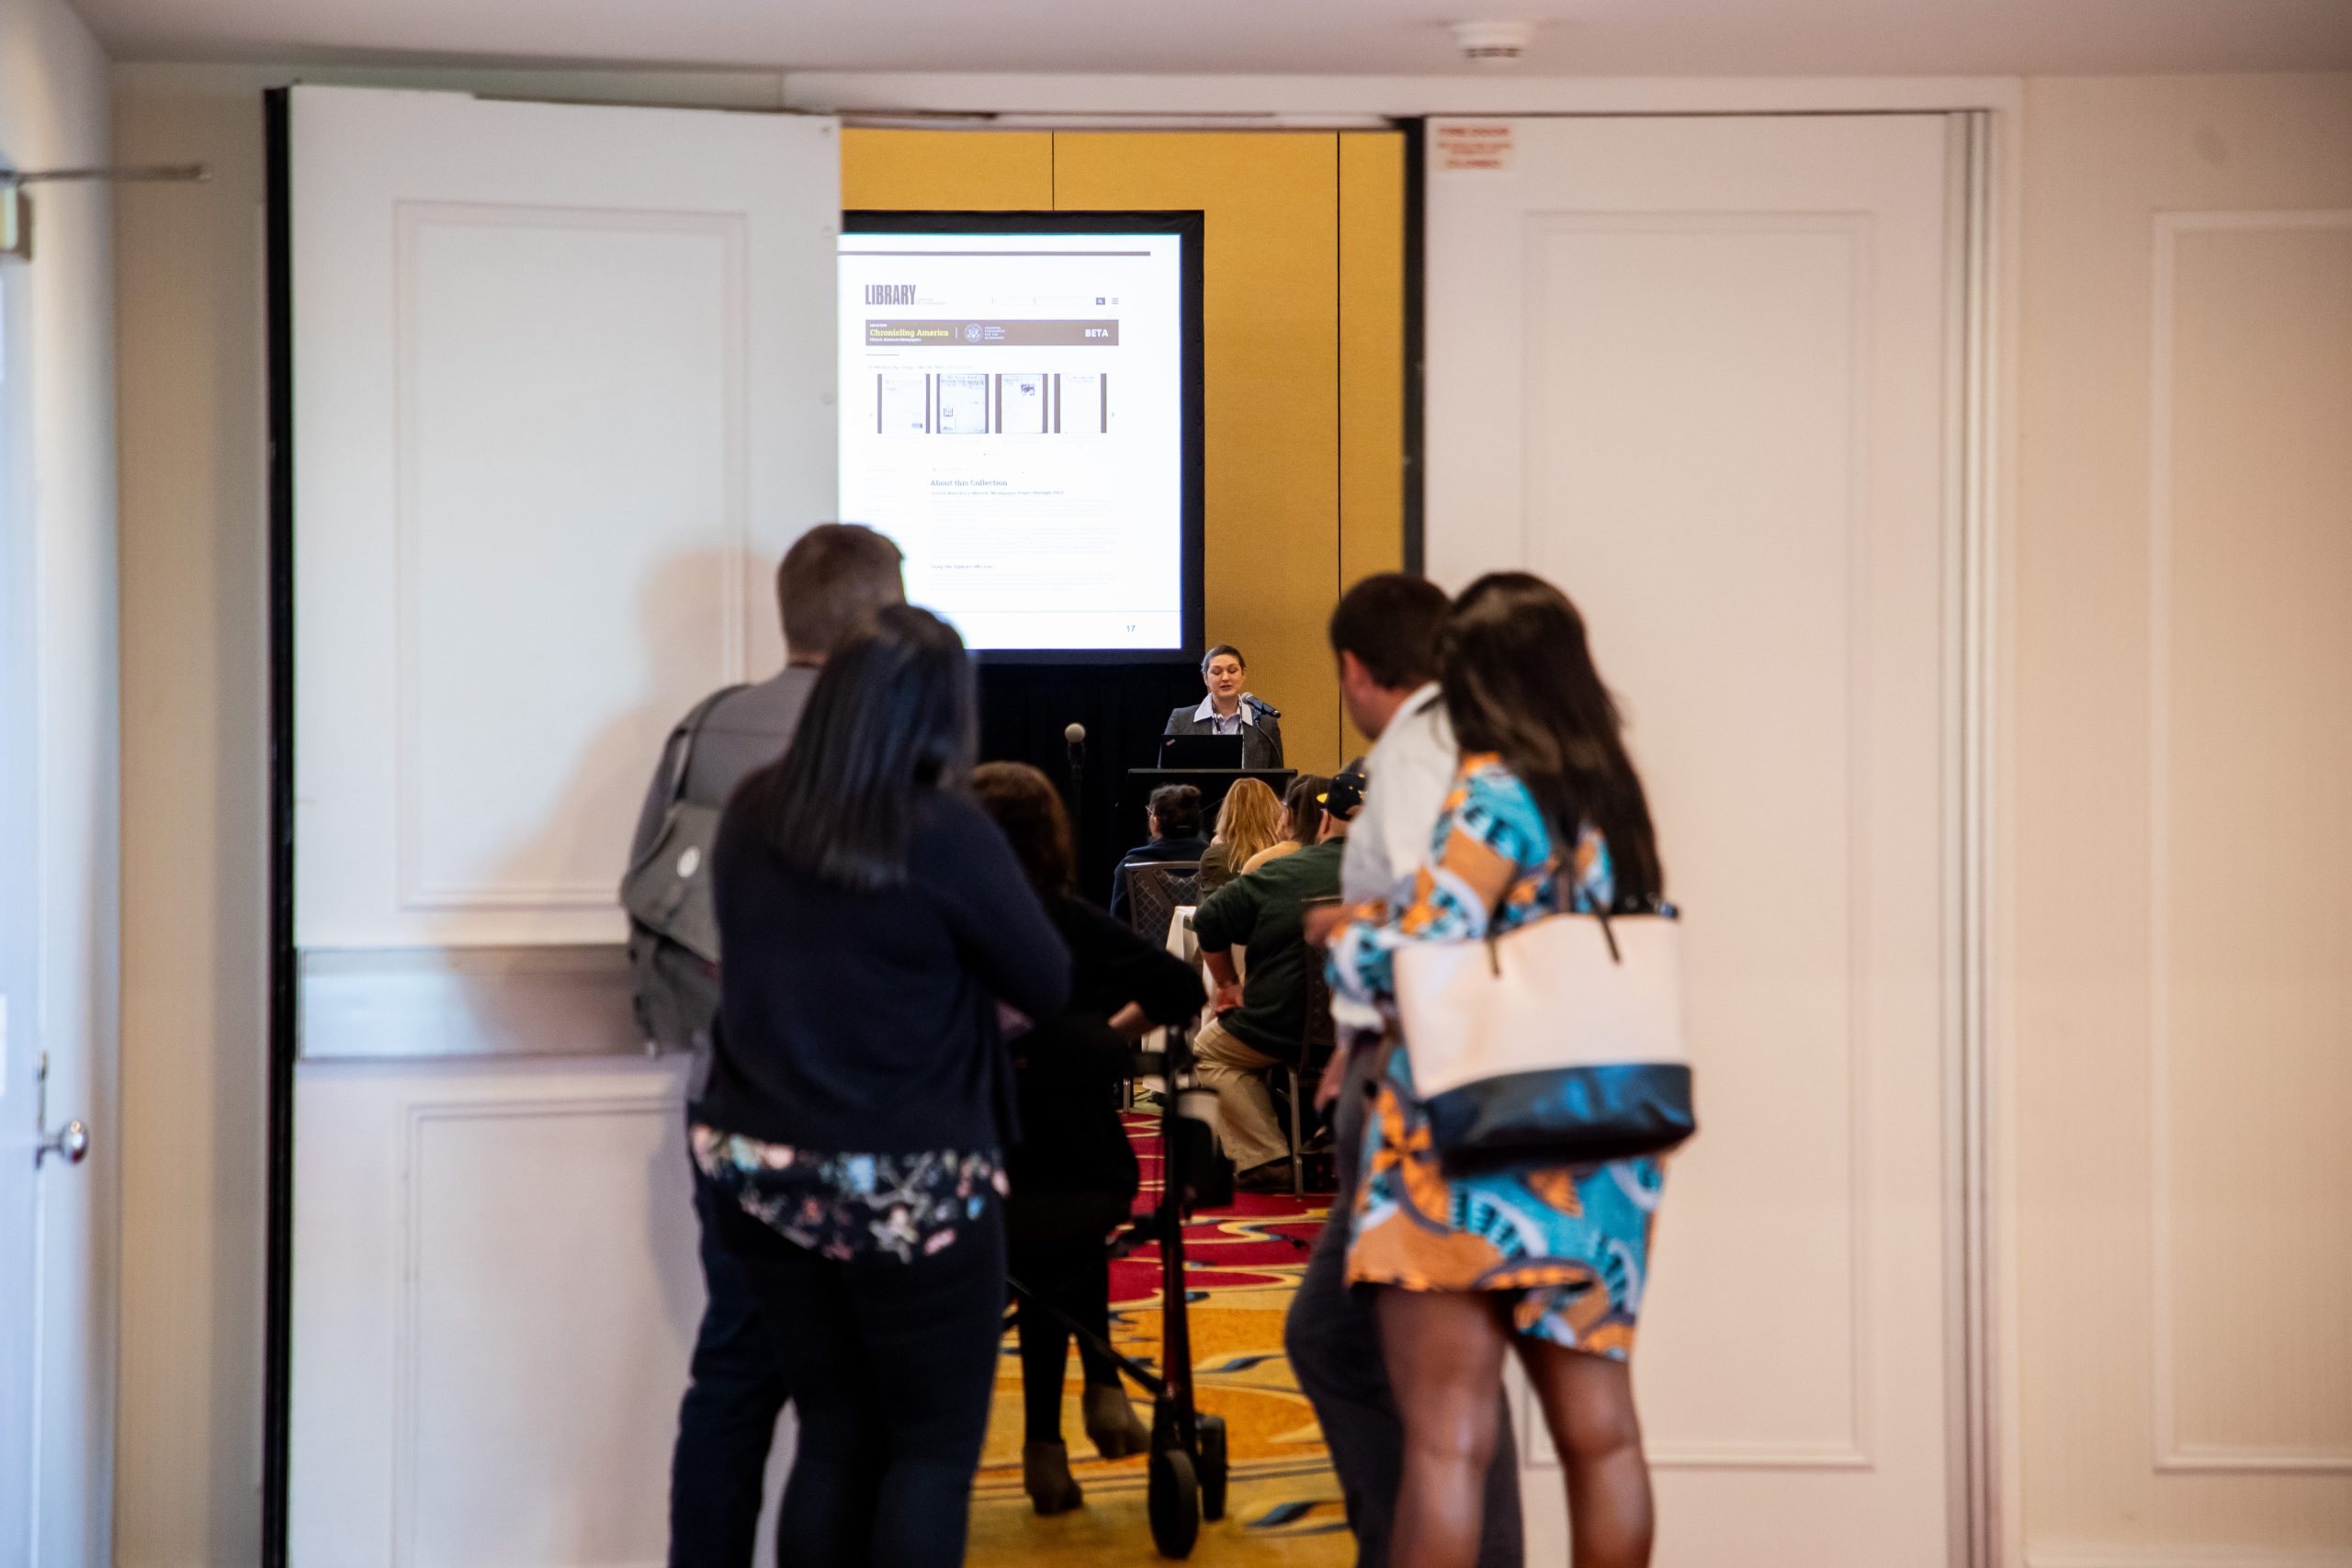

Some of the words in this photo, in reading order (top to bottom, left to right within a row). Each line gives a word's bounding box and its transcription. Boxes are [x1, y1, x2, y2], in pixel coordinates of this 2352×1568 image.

[865, 284, 916, 306] LIBRARY
[869, 328, 915, 338] Chronicling
[916, 328, 949, 337] America
[1084, 329, 1109, 338] BETA
[1126, 625, 1136, 633] 17
